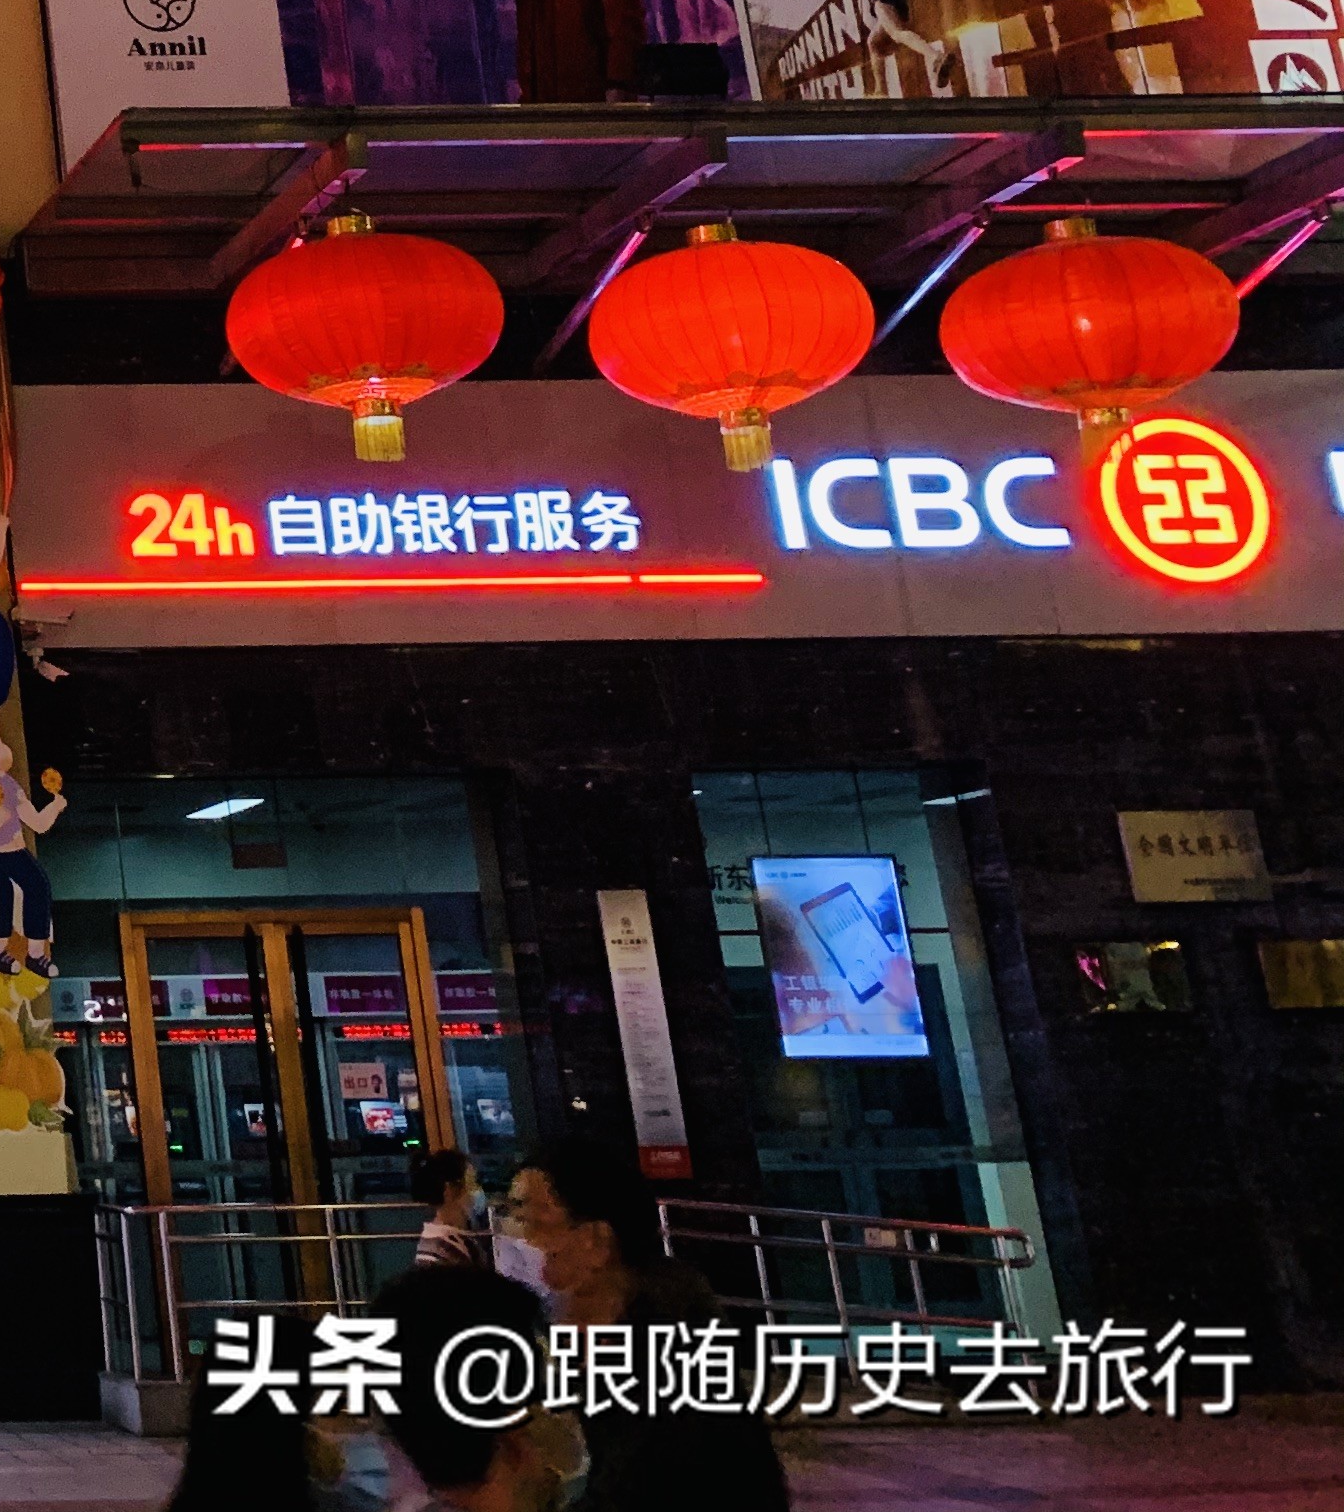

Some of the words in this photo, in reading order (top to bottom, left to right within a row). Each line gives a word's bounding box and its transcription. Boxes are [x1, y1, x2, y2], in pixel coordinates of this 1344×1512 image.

[127, 35, 207, 56] Annil
[127, 492, 255, 556] 24h
[266, 489, 642, 556] 自助银行服务
[771, 456, 1073, 551] ICBC
